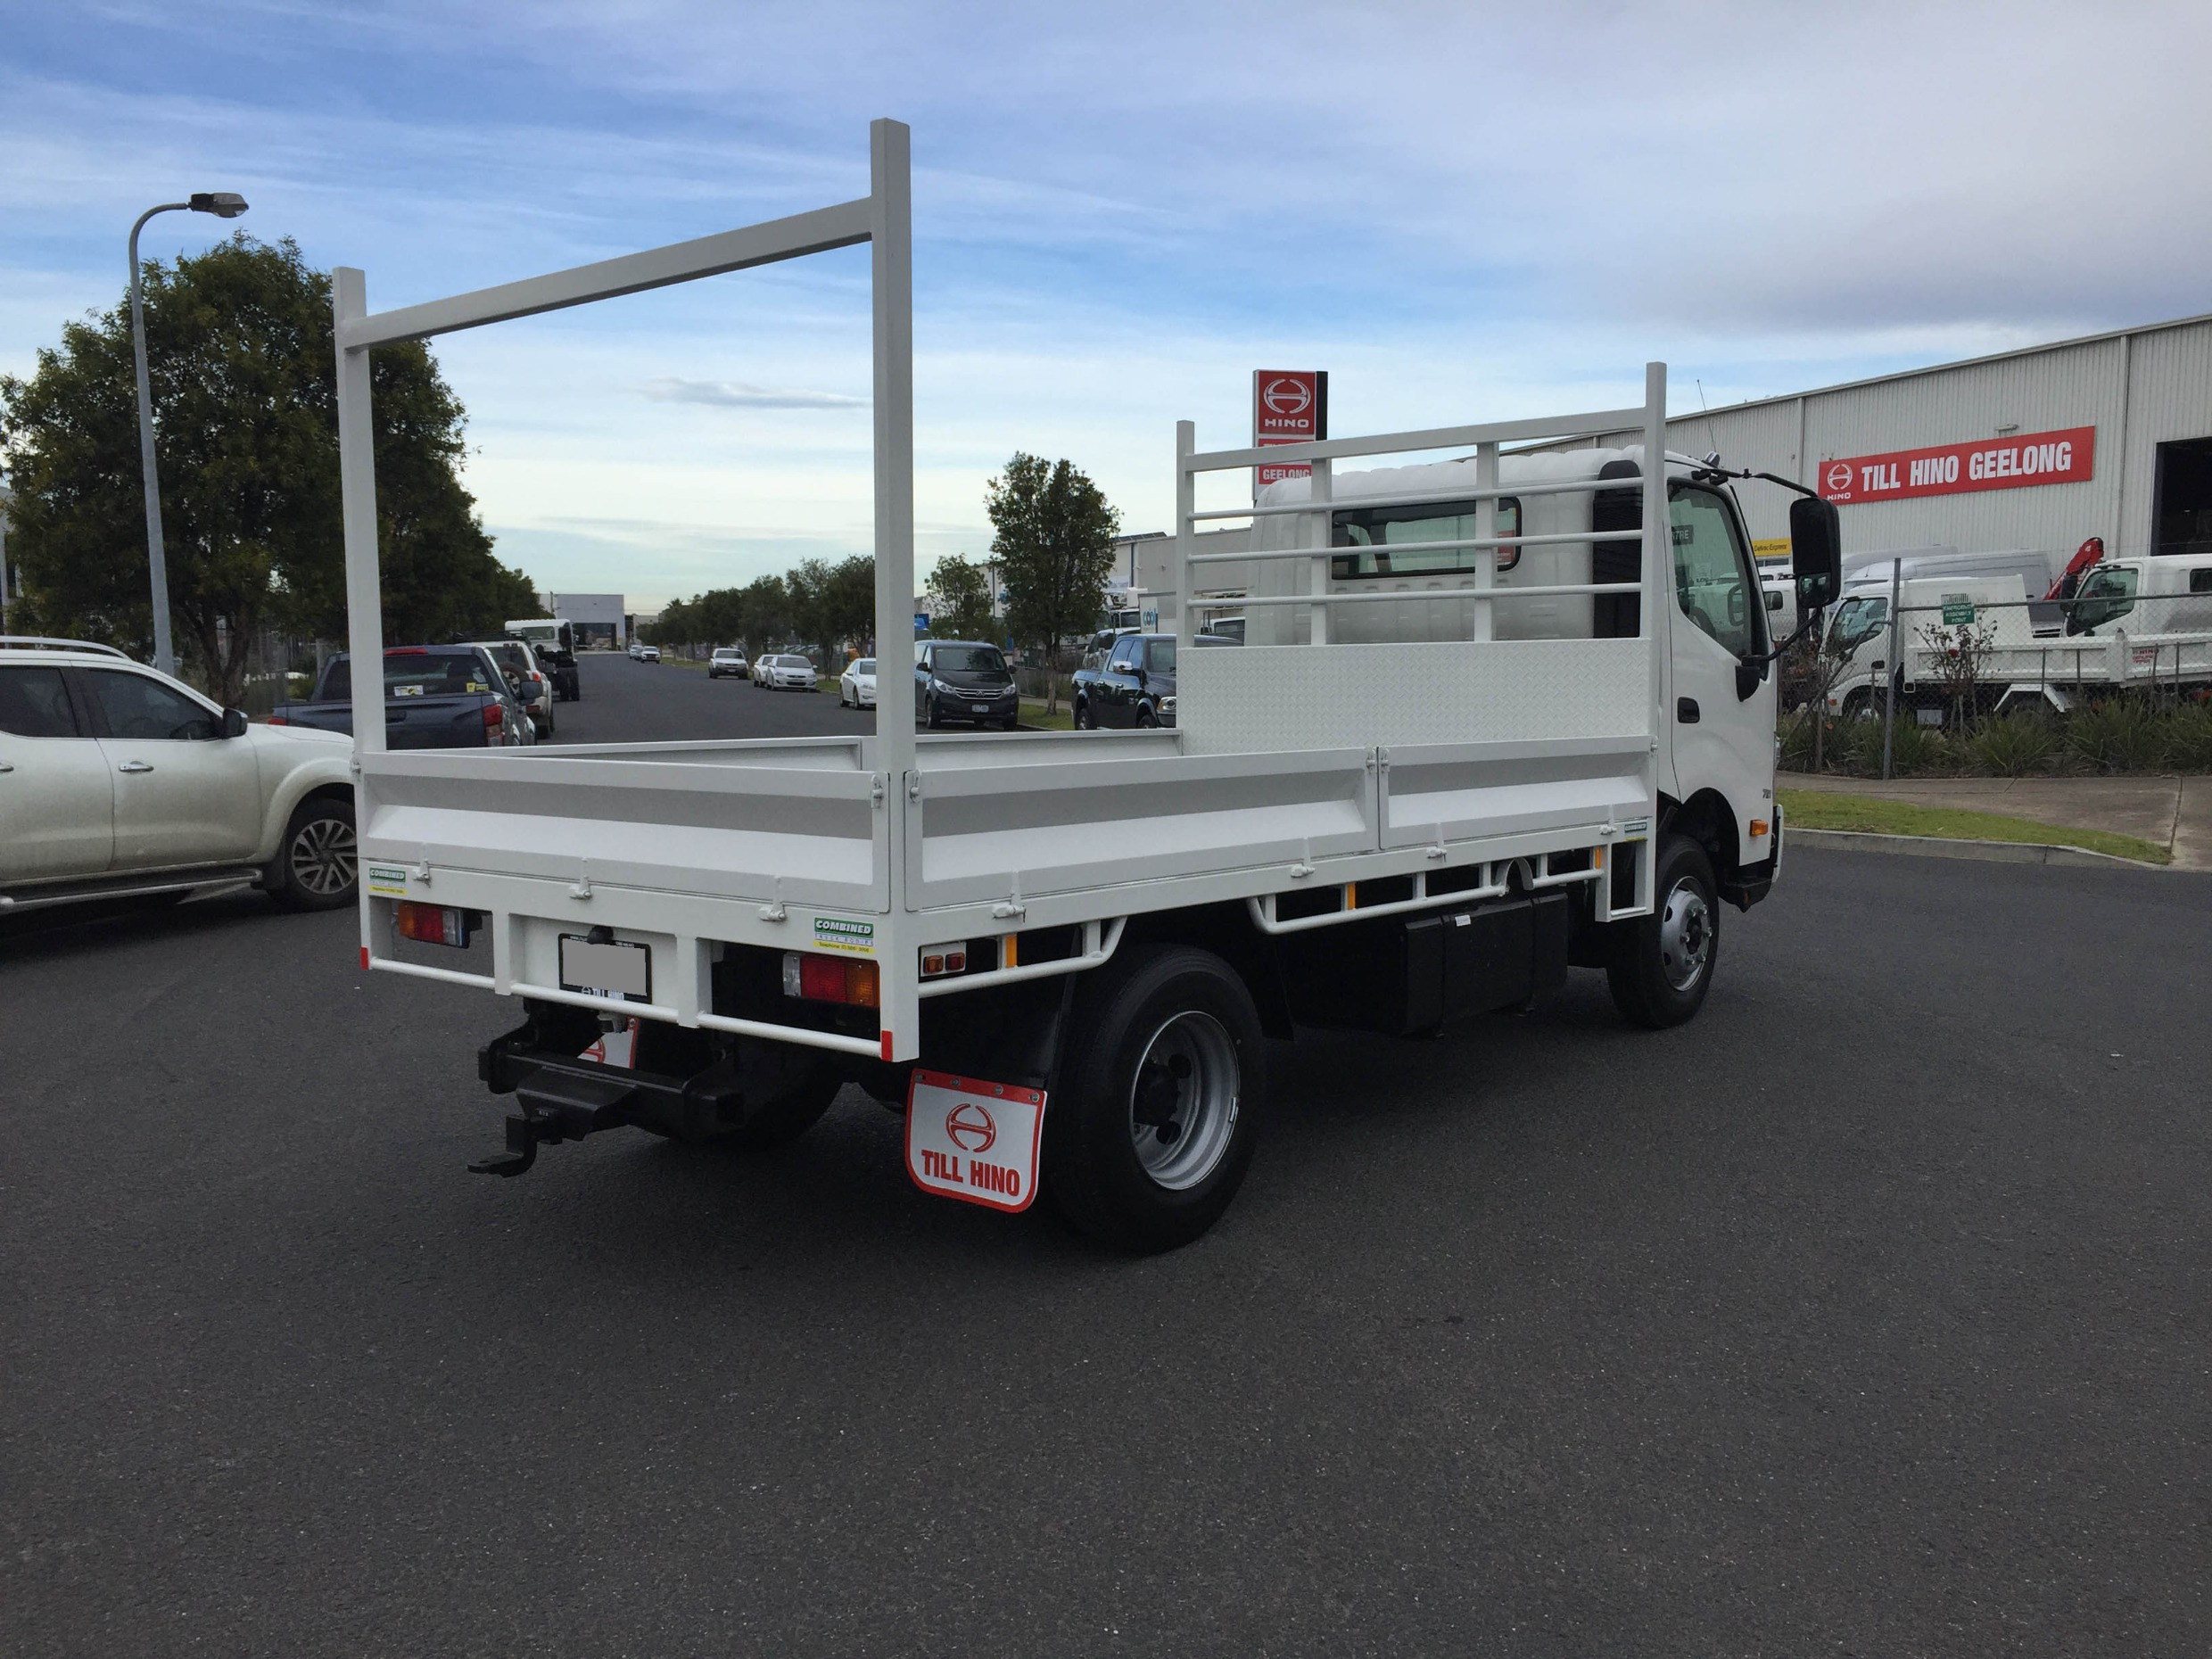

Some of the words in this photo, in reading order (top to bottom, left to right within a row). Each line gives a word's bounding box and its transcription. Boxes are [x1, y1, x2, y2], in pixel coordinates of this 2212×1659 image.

[1265, 418, 1308, 428] HINO
[1861, 463, 1901, 491] TILL
[1910, 455, 1959, 486] HINO
[1969, 442, 2072, 481] GEELONG
[1263, 468, 1310, 480] GEELONG
[1828, 492, 1852, 500] HINO
[816, 920, 871, 935] COMBINED
[921, 1150, 963, 1183] TILL
[970, 1160, 1020, 1197] HINO
